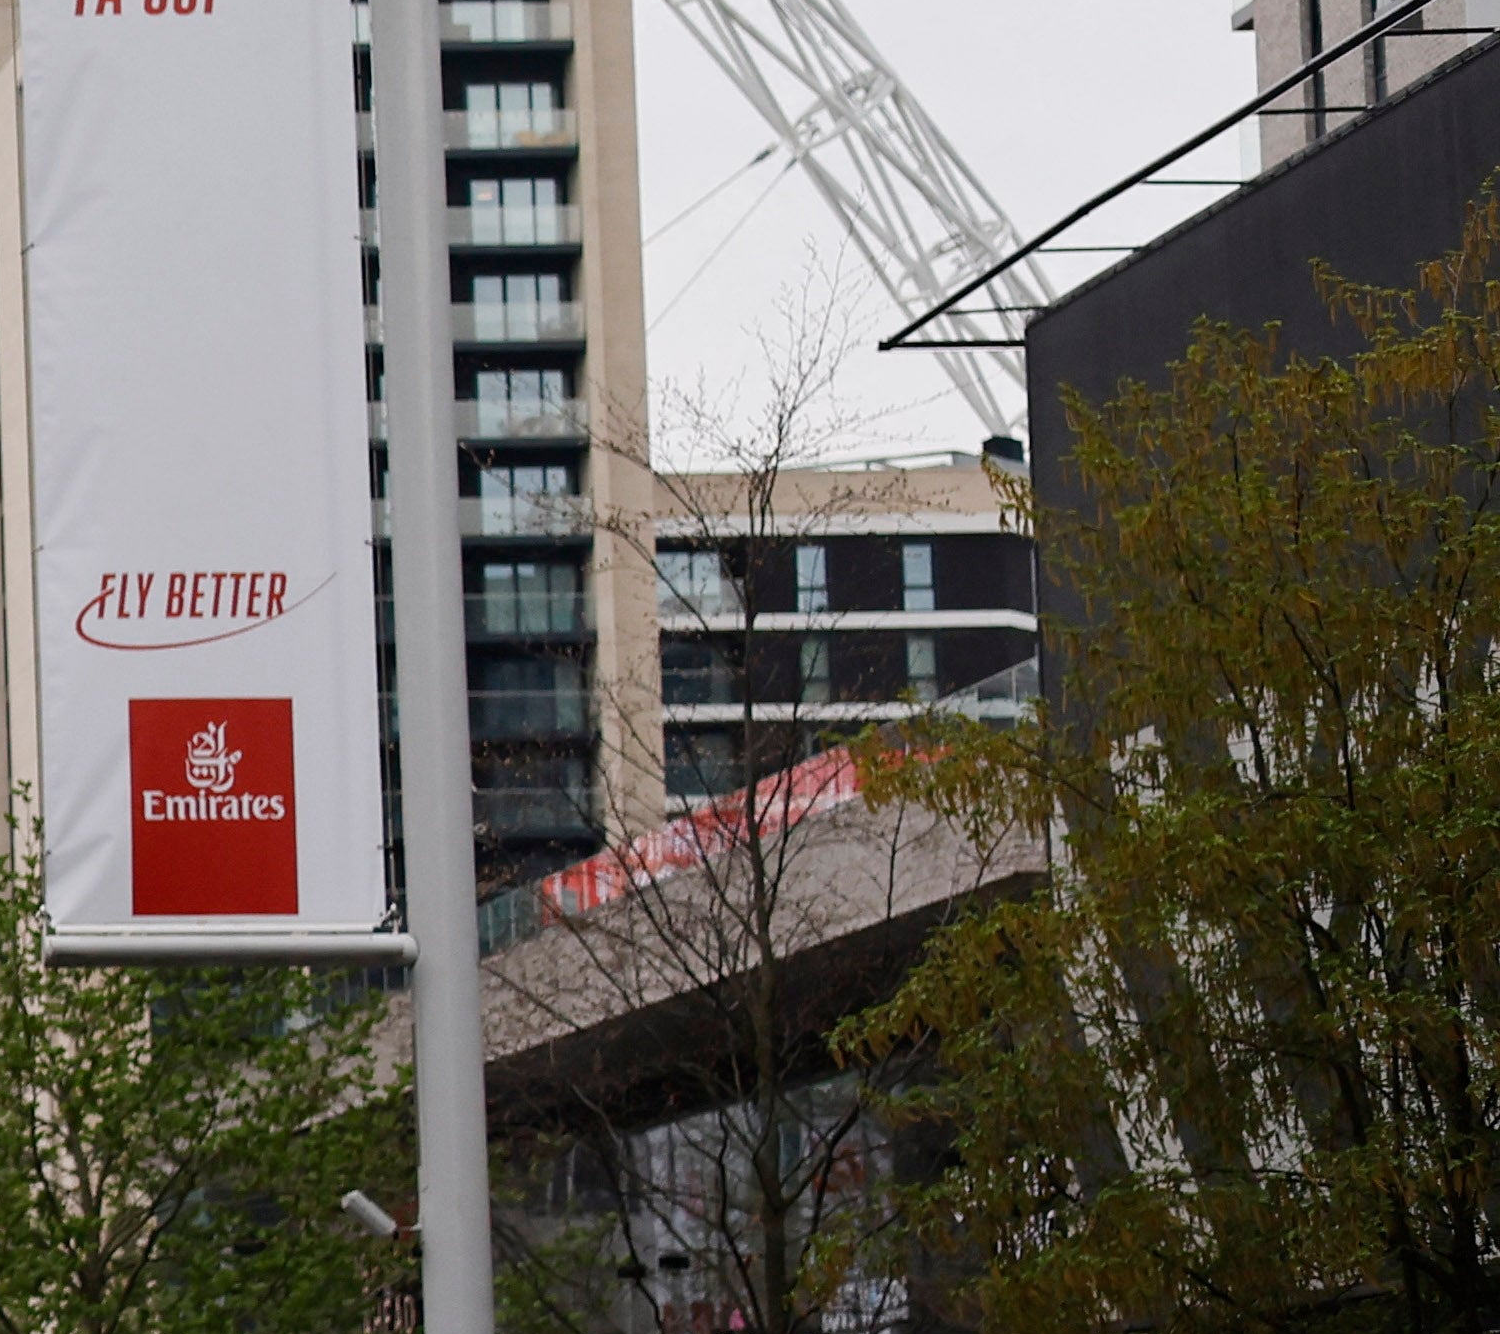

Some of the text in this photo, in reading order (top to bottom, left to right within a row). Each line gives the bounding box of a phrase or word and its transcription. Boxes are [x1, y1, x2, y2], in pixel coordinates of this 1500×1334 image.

[97, 571, 287, 619] FLY BETTER
[142, 789, 285, 822] Emirates
